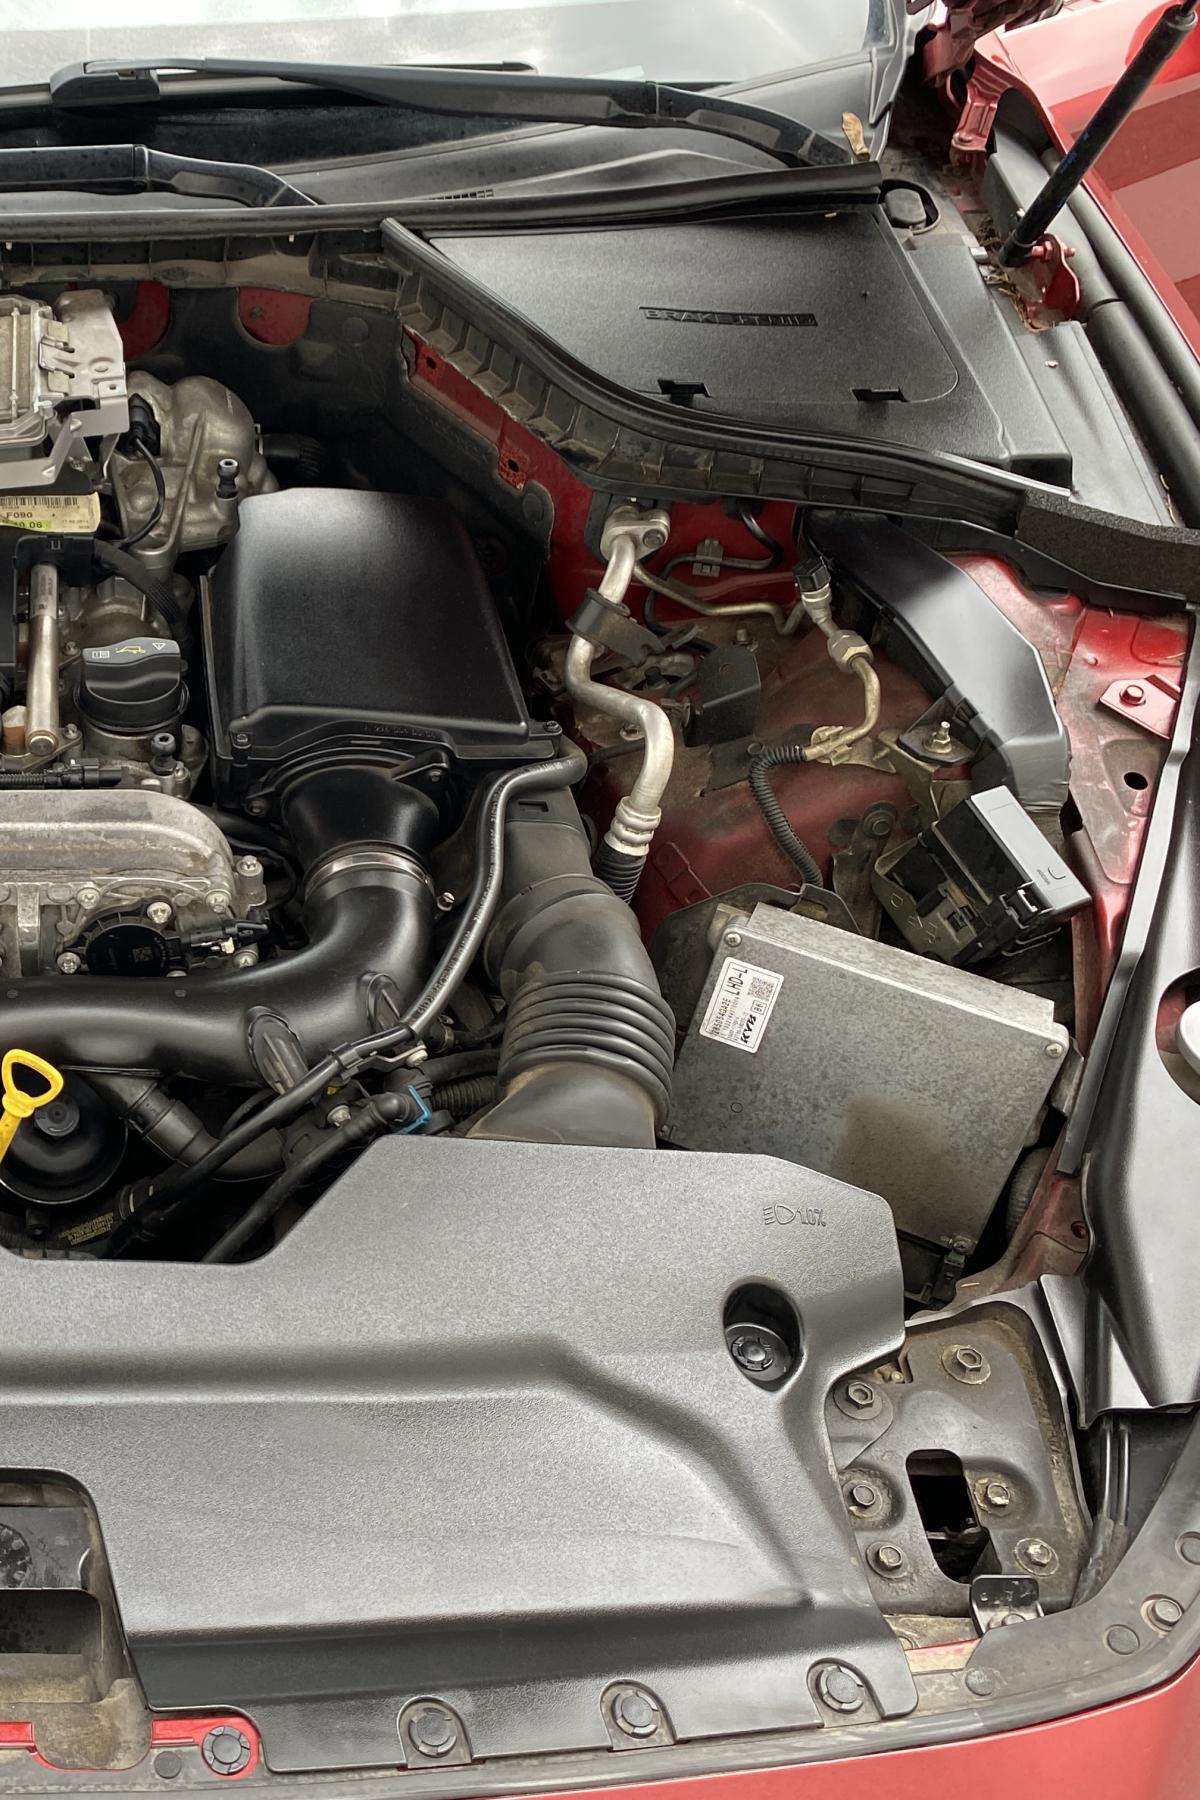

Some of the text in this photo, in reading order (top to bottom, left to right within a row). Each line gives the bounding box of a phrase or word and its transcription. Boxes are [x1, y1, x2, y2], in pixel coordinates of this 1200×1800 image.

[644, 309, 731, 325] BRAKE
[724, 967, 748, 996] LHD-L
[740, 1014, 757, 1044] KYB
